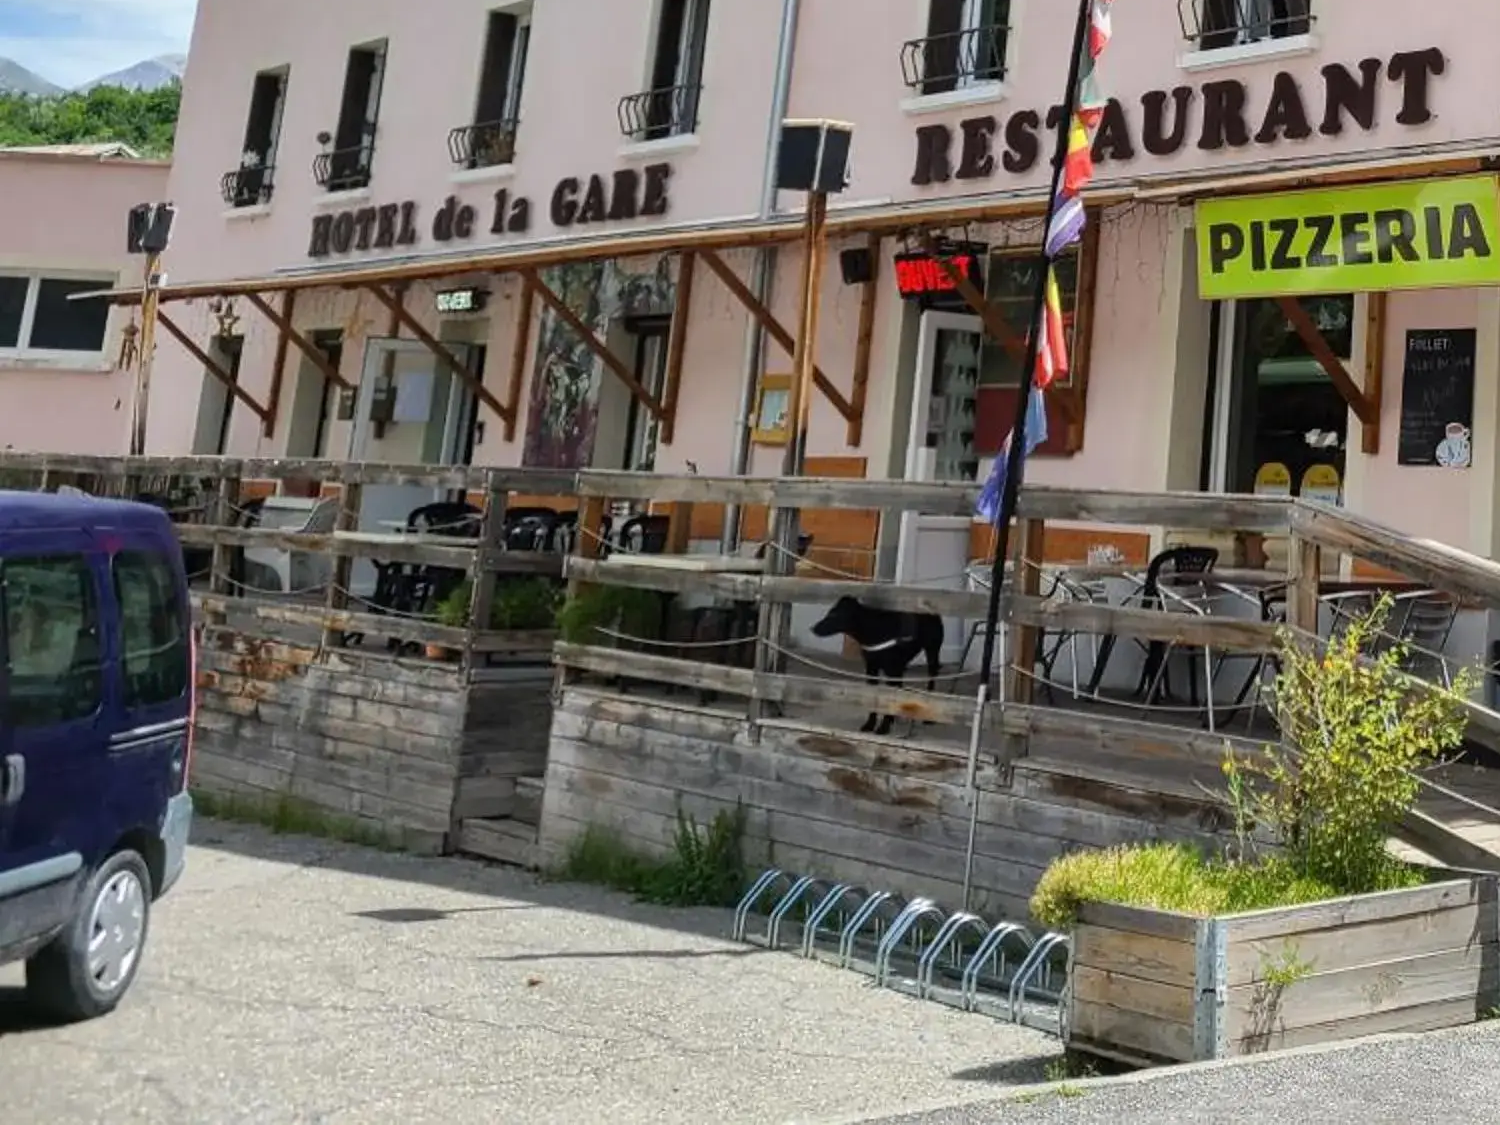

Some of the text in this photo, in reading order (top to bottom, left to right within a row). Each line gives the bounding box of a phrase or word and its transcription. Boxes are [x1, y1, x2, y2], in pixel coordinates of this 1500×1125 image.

[308, 162, 674, 258] HOTEL de la GARE
[1209, 203, 1491, 273] PIZZERIA
[895, 256, 971, 292] OUVET
